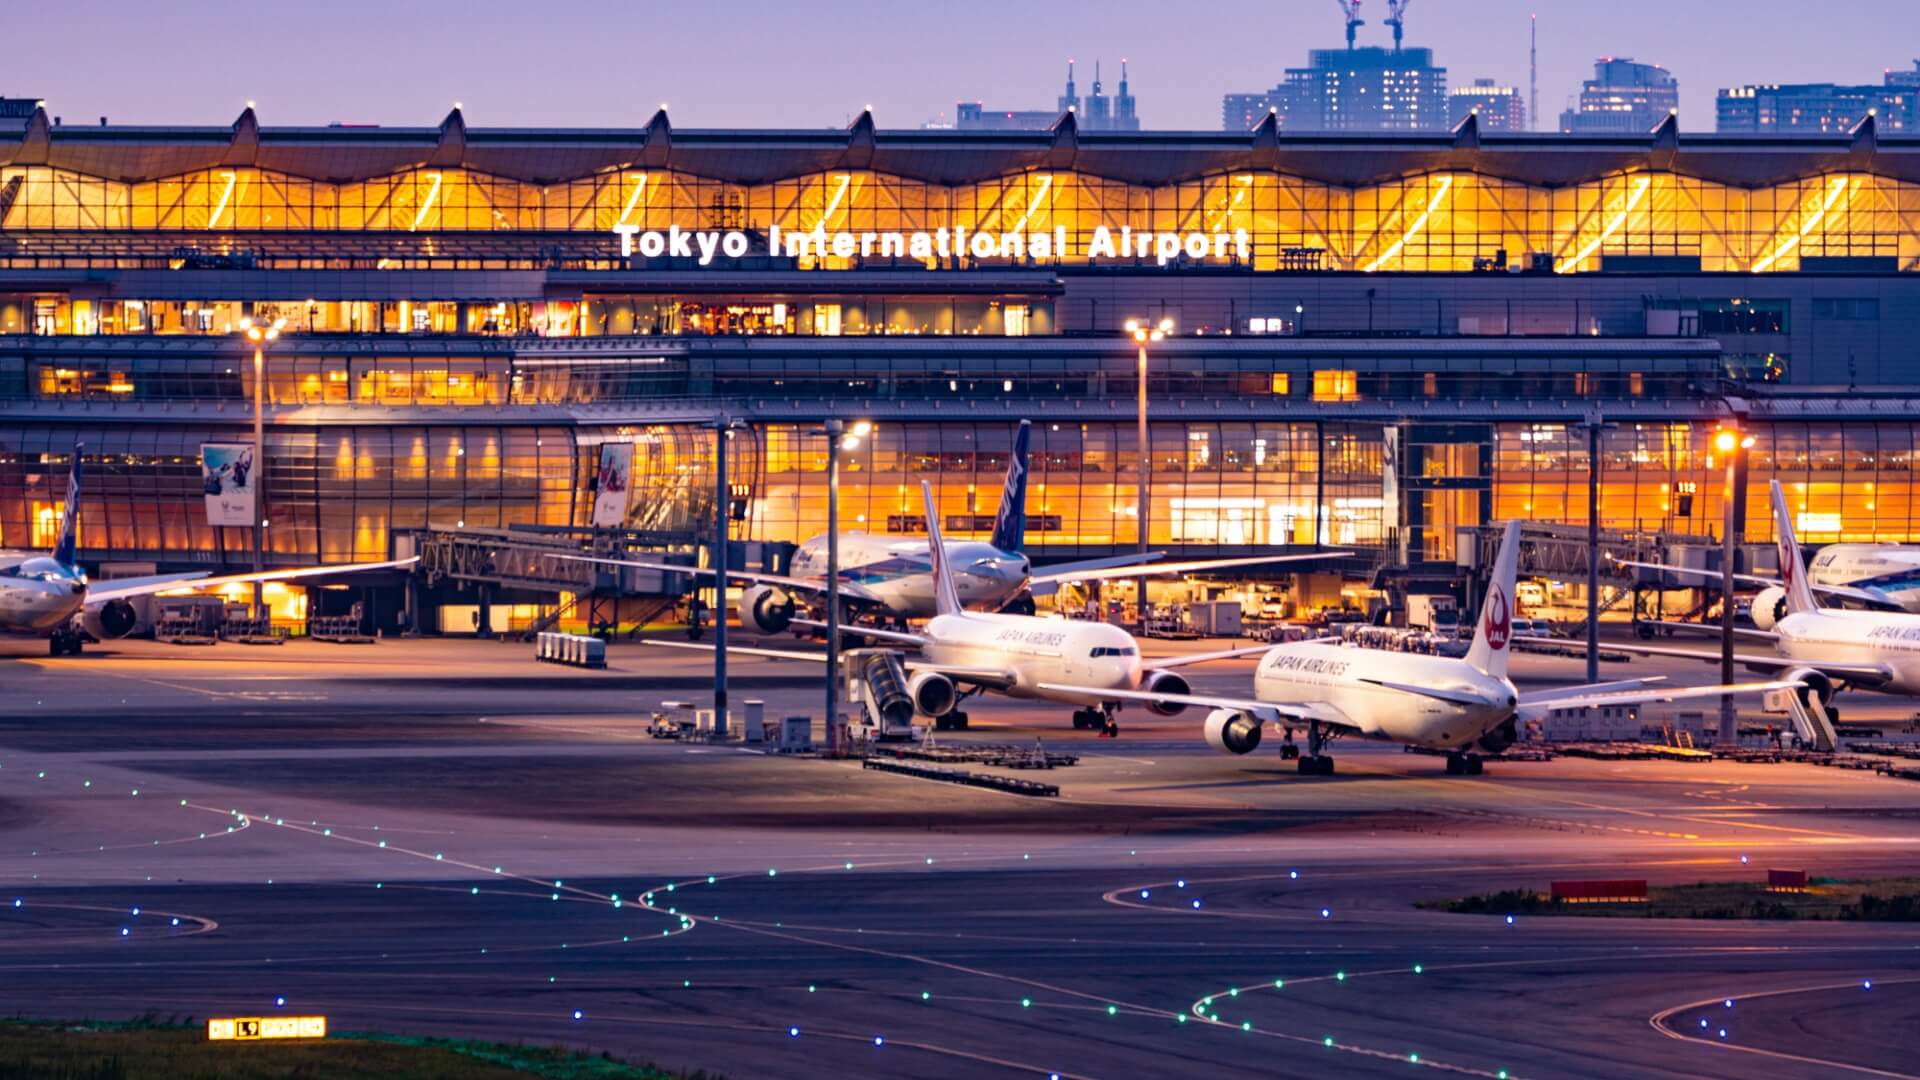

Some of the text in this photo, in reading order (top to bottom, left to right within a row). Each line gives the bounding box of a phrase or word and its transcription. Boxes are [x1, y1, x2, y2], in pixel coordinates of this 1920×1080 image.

[613, 225, 1250, 265] Tokyo International Airport
[996, 628, 1067, 646] JAPAN AIRLINES
[1489, 631, 1505, 642] JAL
[1867, 625, 1901, 640] JAPAN
[1270, 656, 1350, 676] JAPAN AIRLINES
[238, 1022, 259, 1036] L9
